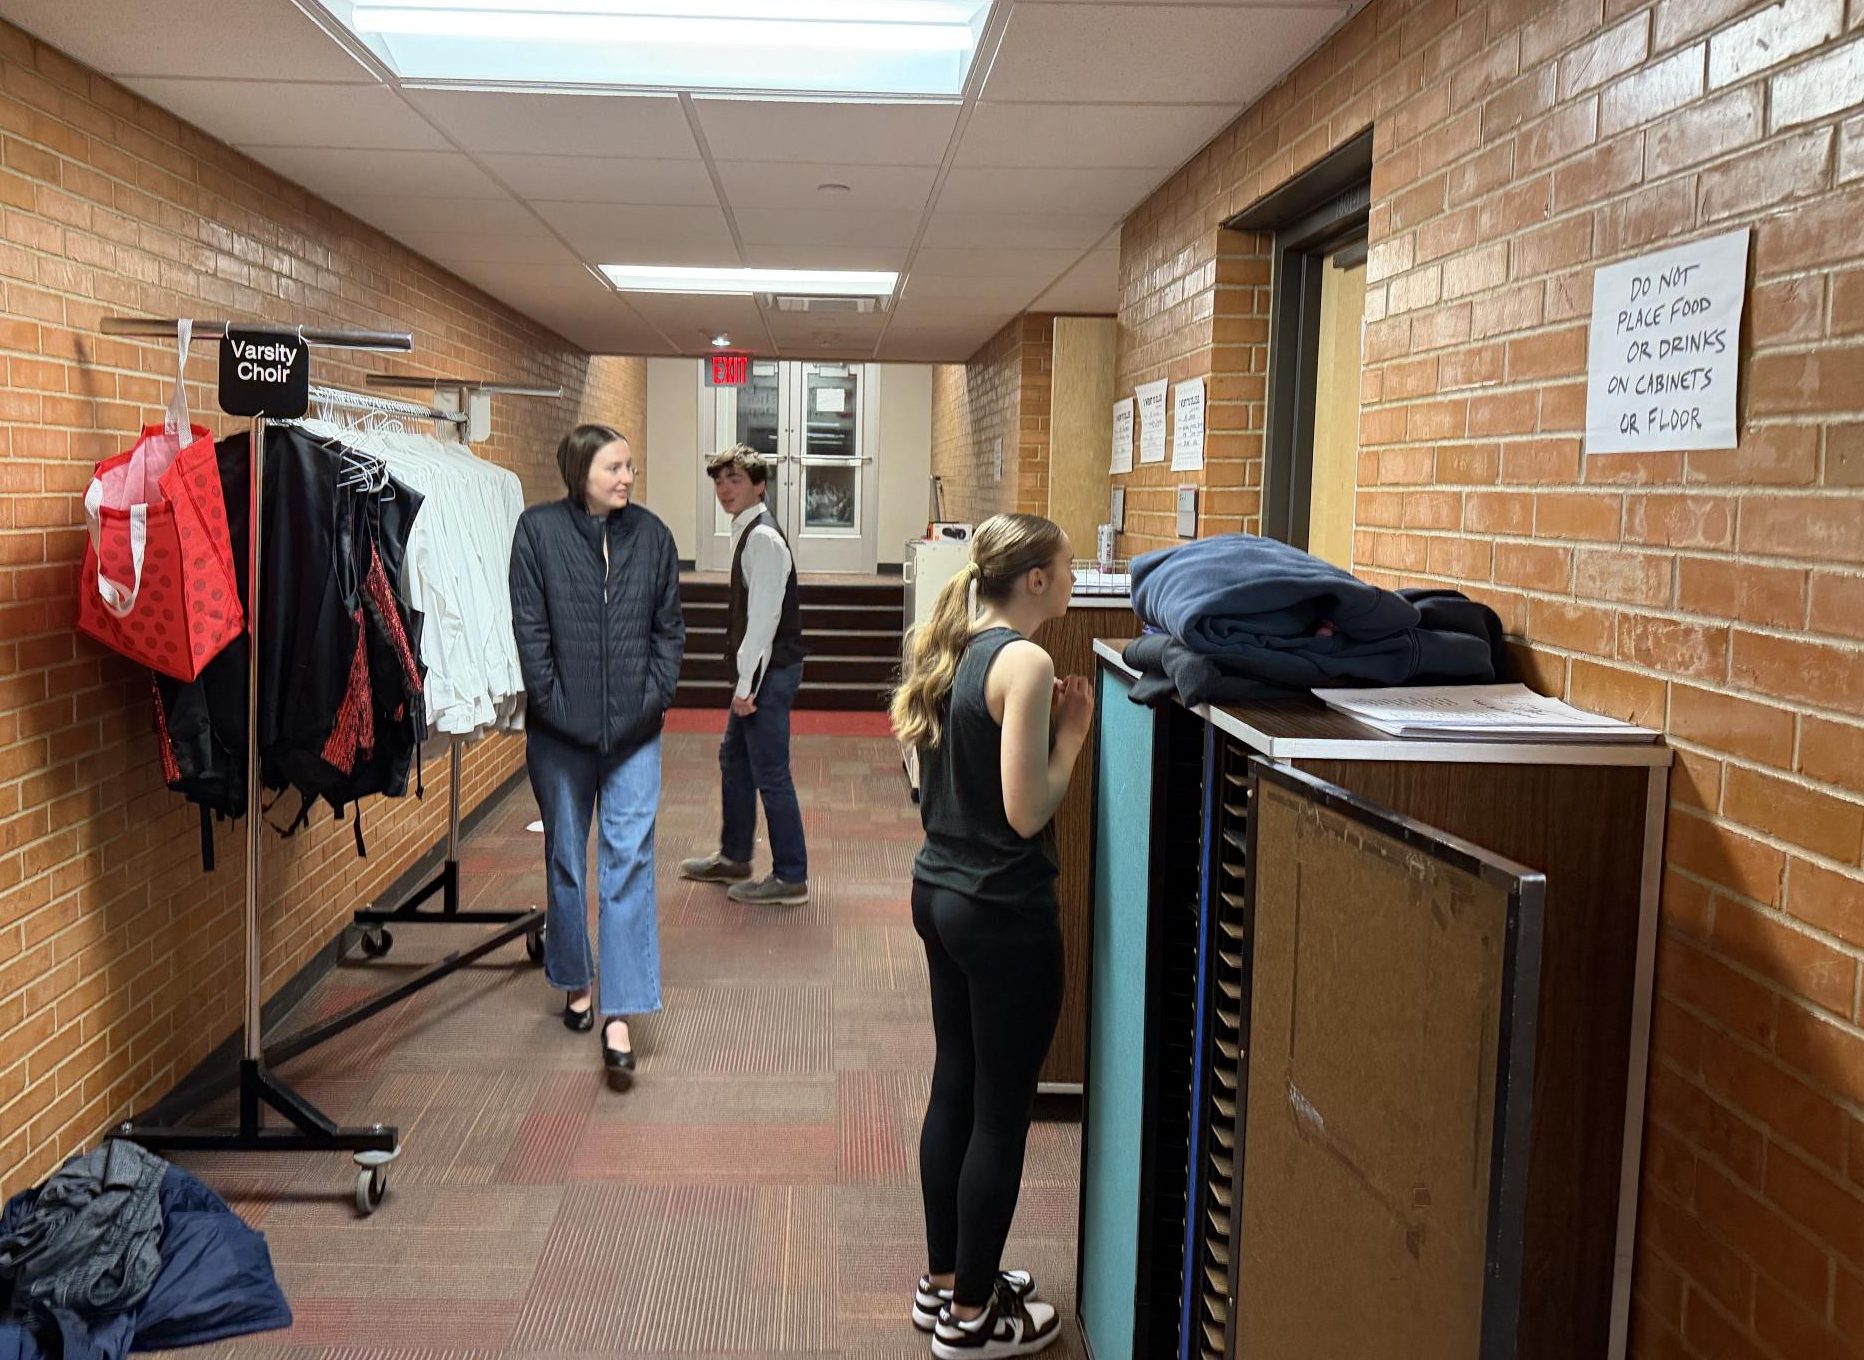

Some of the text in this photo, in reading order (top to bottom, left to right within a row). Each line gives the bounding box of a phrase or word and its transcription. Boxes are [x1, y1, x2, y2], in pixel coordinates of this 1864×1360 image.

[1631, 264, 1700, 302] DO NOT
[1616, 296, 1712, 334] PLACE FOOD
[231, 340, 297, 366] Varsity
[1626, 328, 1727, 364] OR DRINKS
[237, 362, 290, 383] Choir
[712, 356, 748, 385] EXIT
[1607, 367, 1713, 395] ON CABINETS
[1620, 406, 1702, 435] OR FLOOR
